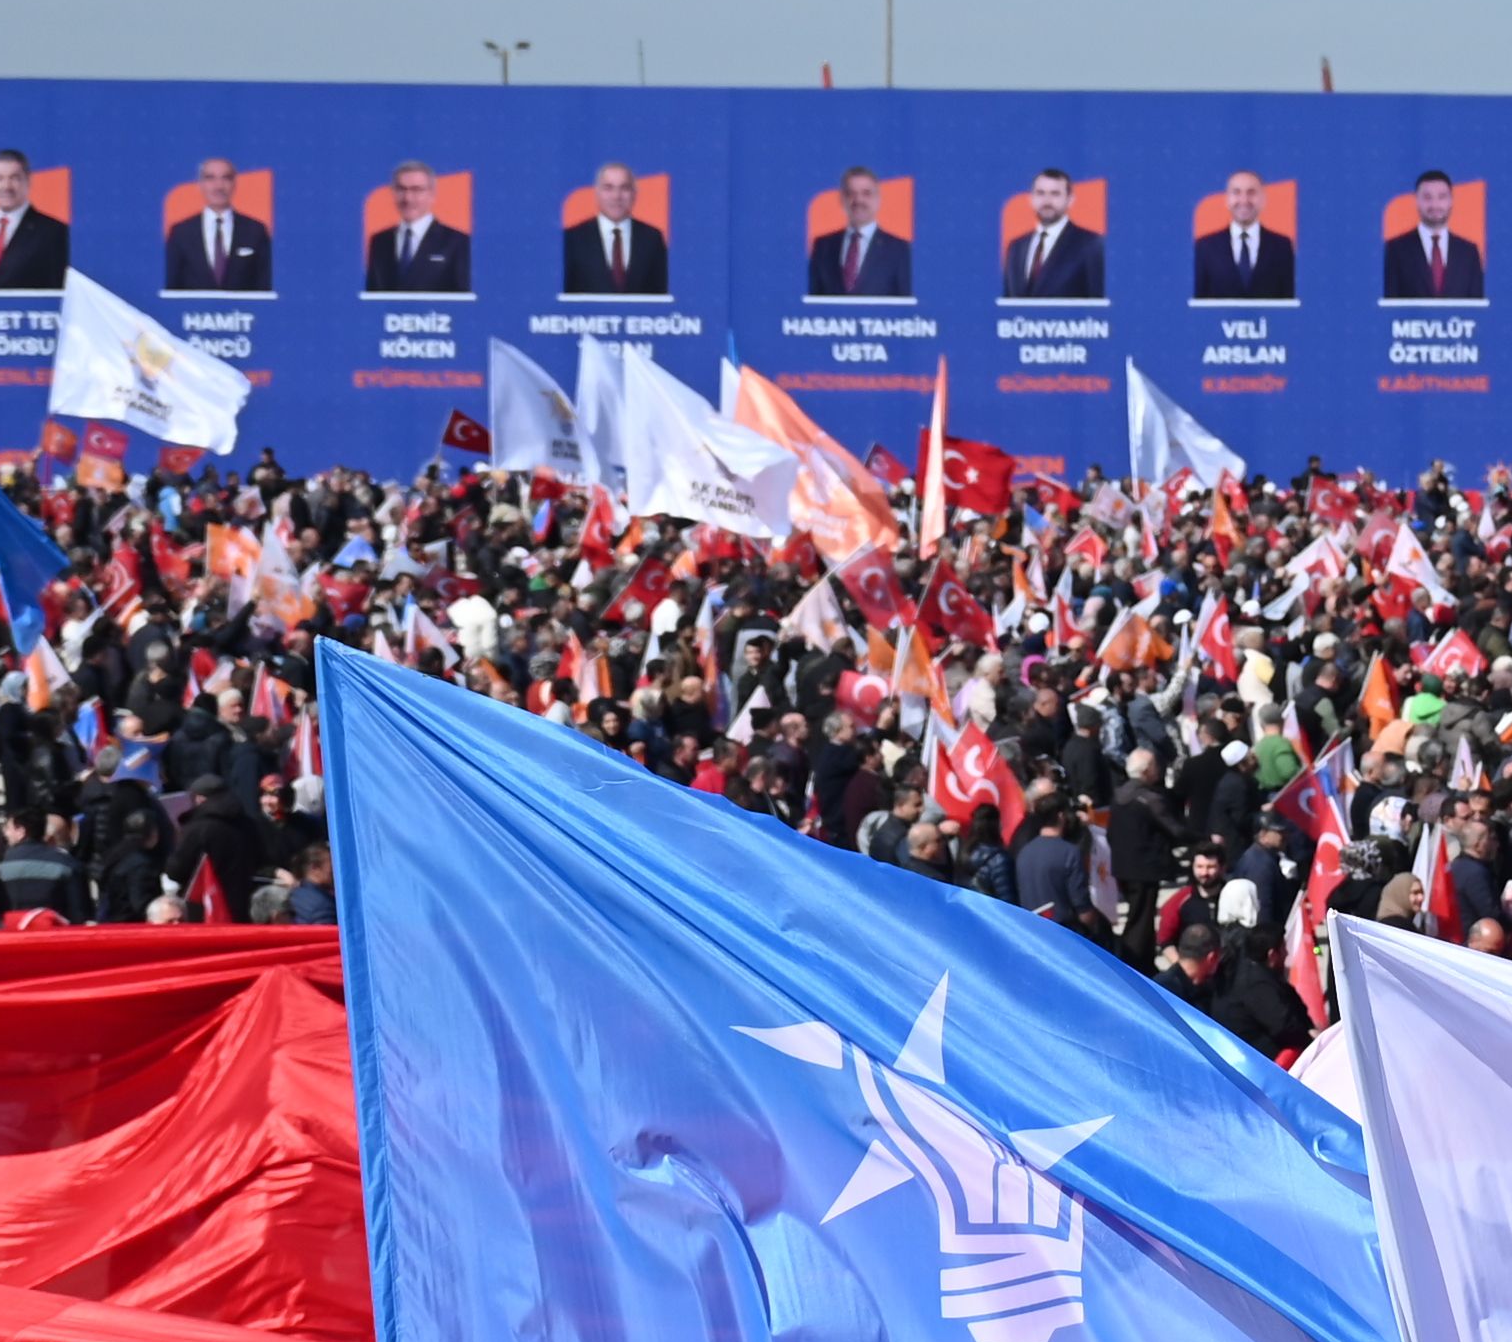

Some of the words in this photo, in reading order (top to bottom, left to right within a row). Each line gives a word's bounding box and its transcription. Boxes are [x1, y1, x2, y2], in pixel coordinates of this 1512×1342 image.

[182, 309, 255, 333] HAMİT
[384, 309, 451, 334] DENİZ
[530, 315, 623, 334] MEHMET
[626, 311, 702, 336] ERGÜN
[782, 318, 858, 336] HASAN
[860, 314, 937, 338] TAHSİN
[997, 315, 1109, 339] BÜNYAMİN
[1221, 316, 1267, 340] VELİ
[1391, 315, 1476, 339] MEVLÜT
[380, 336, 455, 359] KÖKEN
[832, 343, 888, 363] USTA
[1019, 341, 1087, 364] DEMİR
[1202, 345, 1286, 364] ARSLAN
[1389, 341, 1478, 364] ÖZTEKİN
